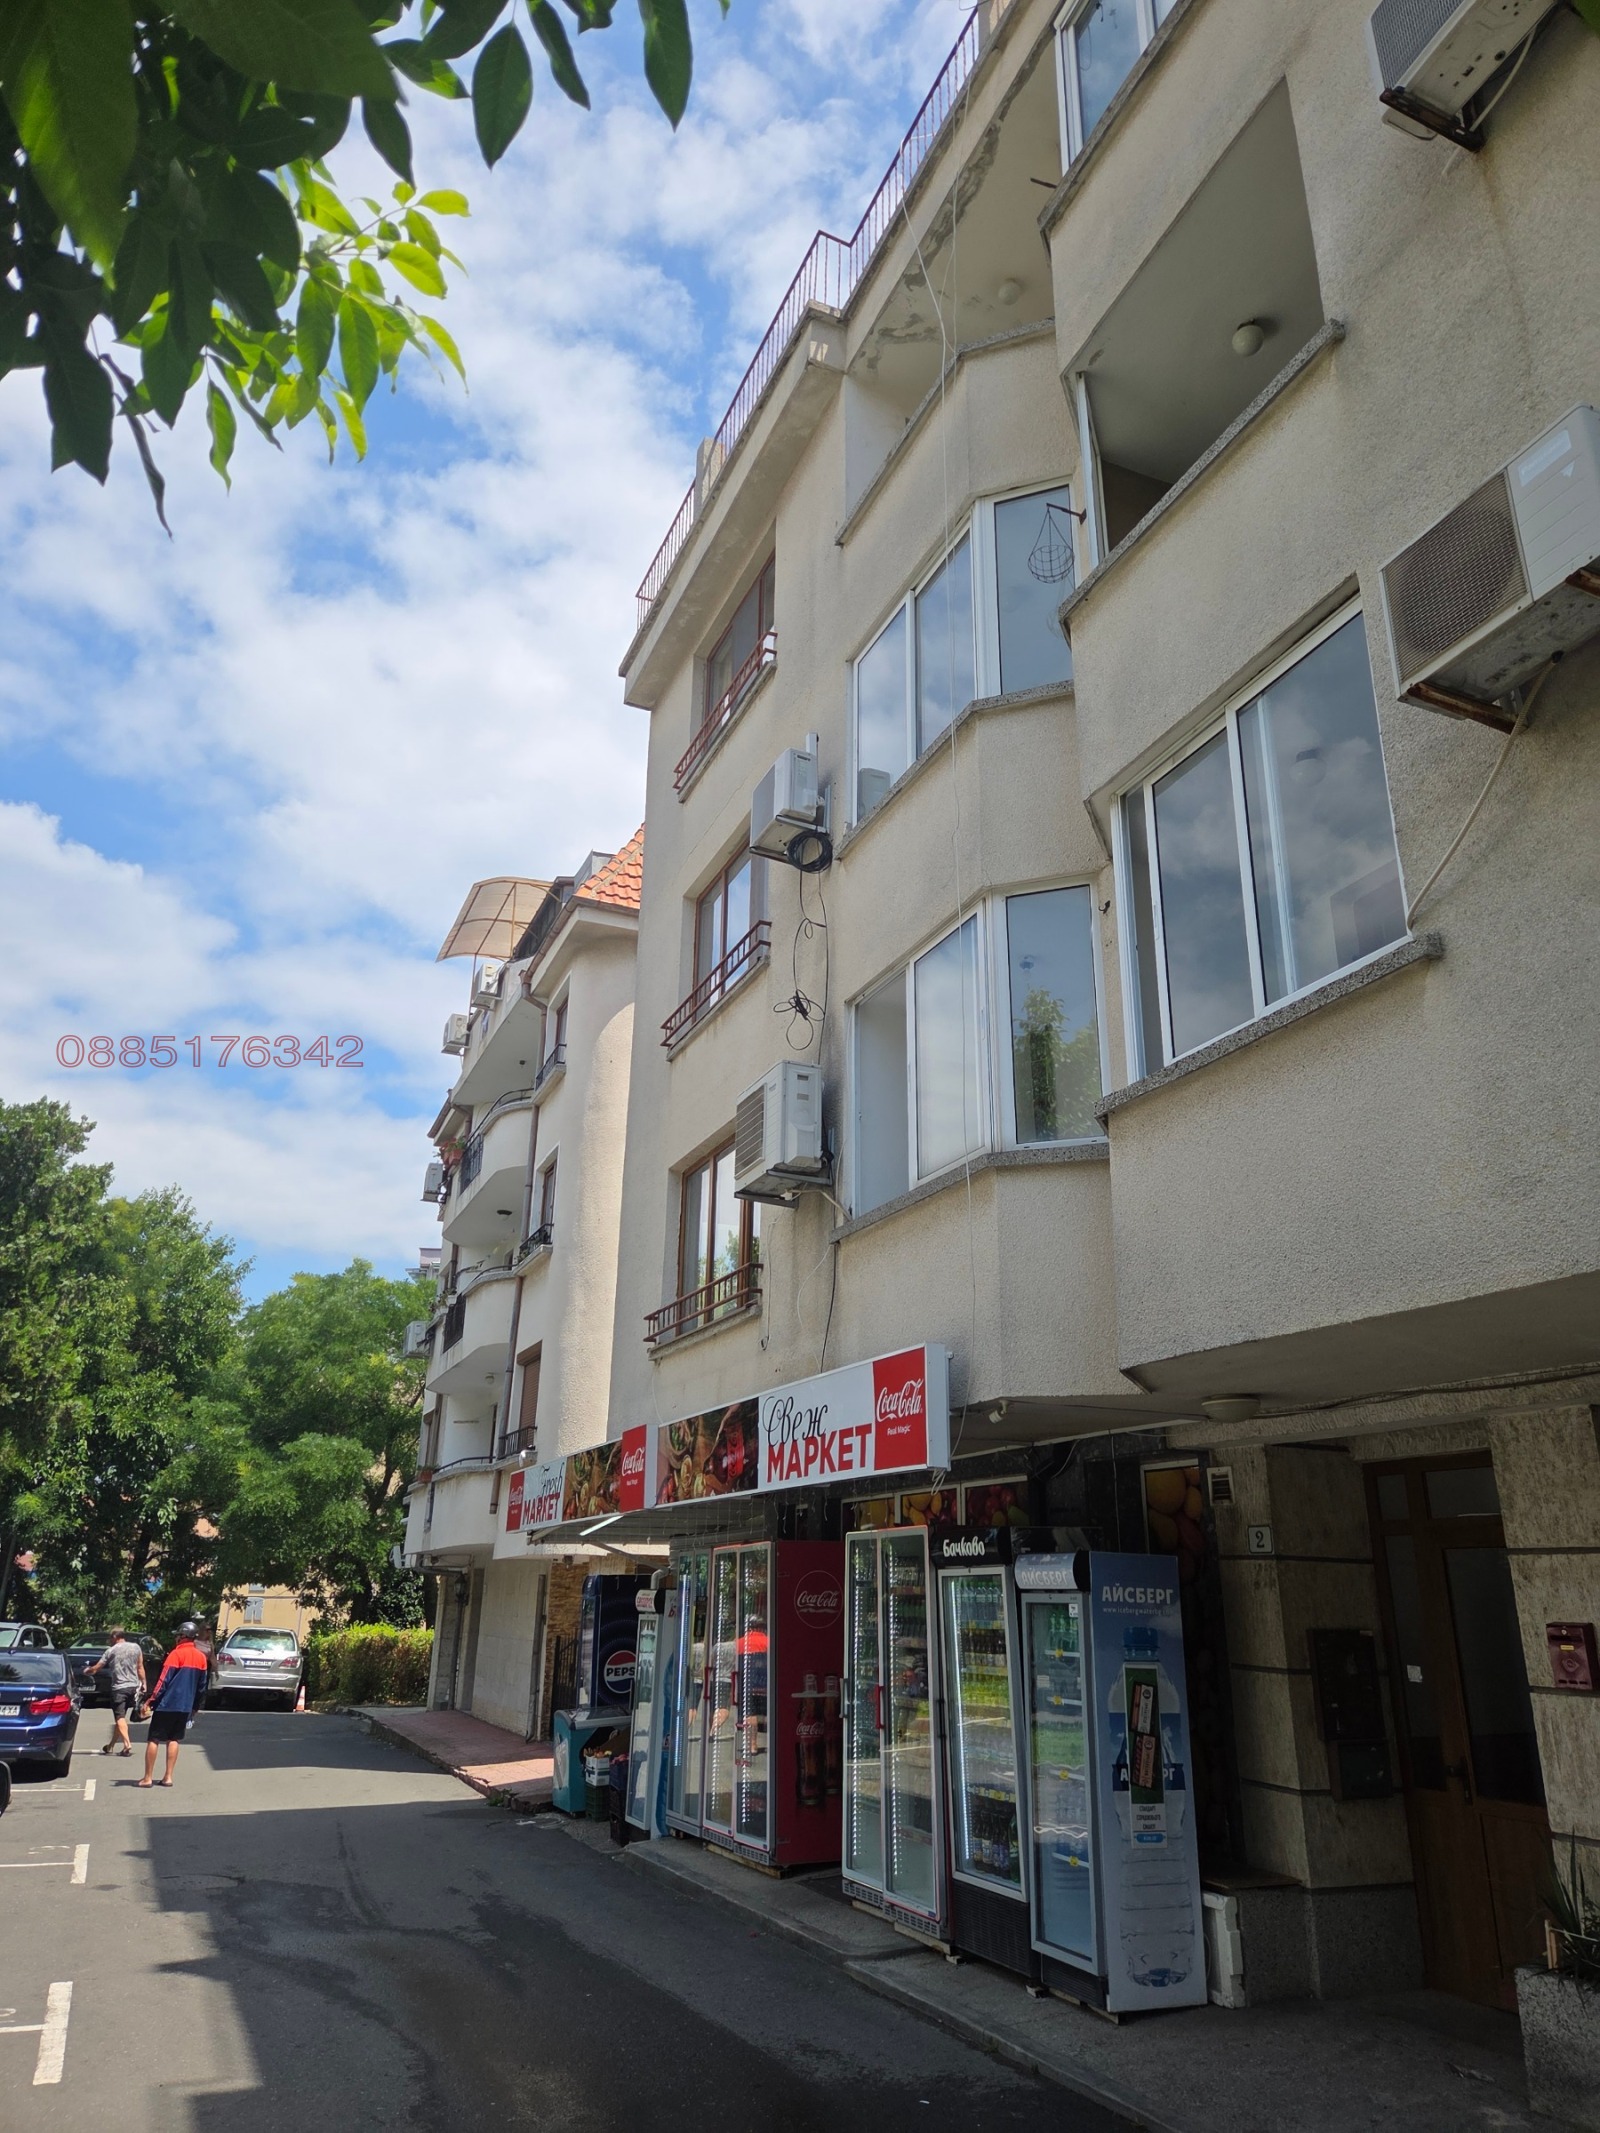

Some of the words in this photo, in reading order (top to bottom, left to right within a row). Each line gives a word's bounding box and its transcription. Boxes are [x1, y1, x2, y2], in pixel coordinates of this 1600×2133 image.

[877, 1378, 924, 1422] Coca-Cola
[762, 1396, 828, 1447] Свеж
[887, 1426, 897, 1436] Real
[898, 1424, 911, 1435] Magic
[621, 1447, 645, 1477] Coca-Cola
[767, 1423, 872, 1483] МАРКЕТ
[522, 1492, 560, 1525] MARKET
[943, 1536, 985, 1557] Бачково
[1255, 1530, 1265, 1548] 2
[1020, 1567, 1068, 1585] АЙСБЕРГ
[797, 1590, 839, 1607] Coca-Cola
[1101, 1583, 1174, 1604] АЙСБЕРГ
[606, 1667, 636, 1677] PEPS
